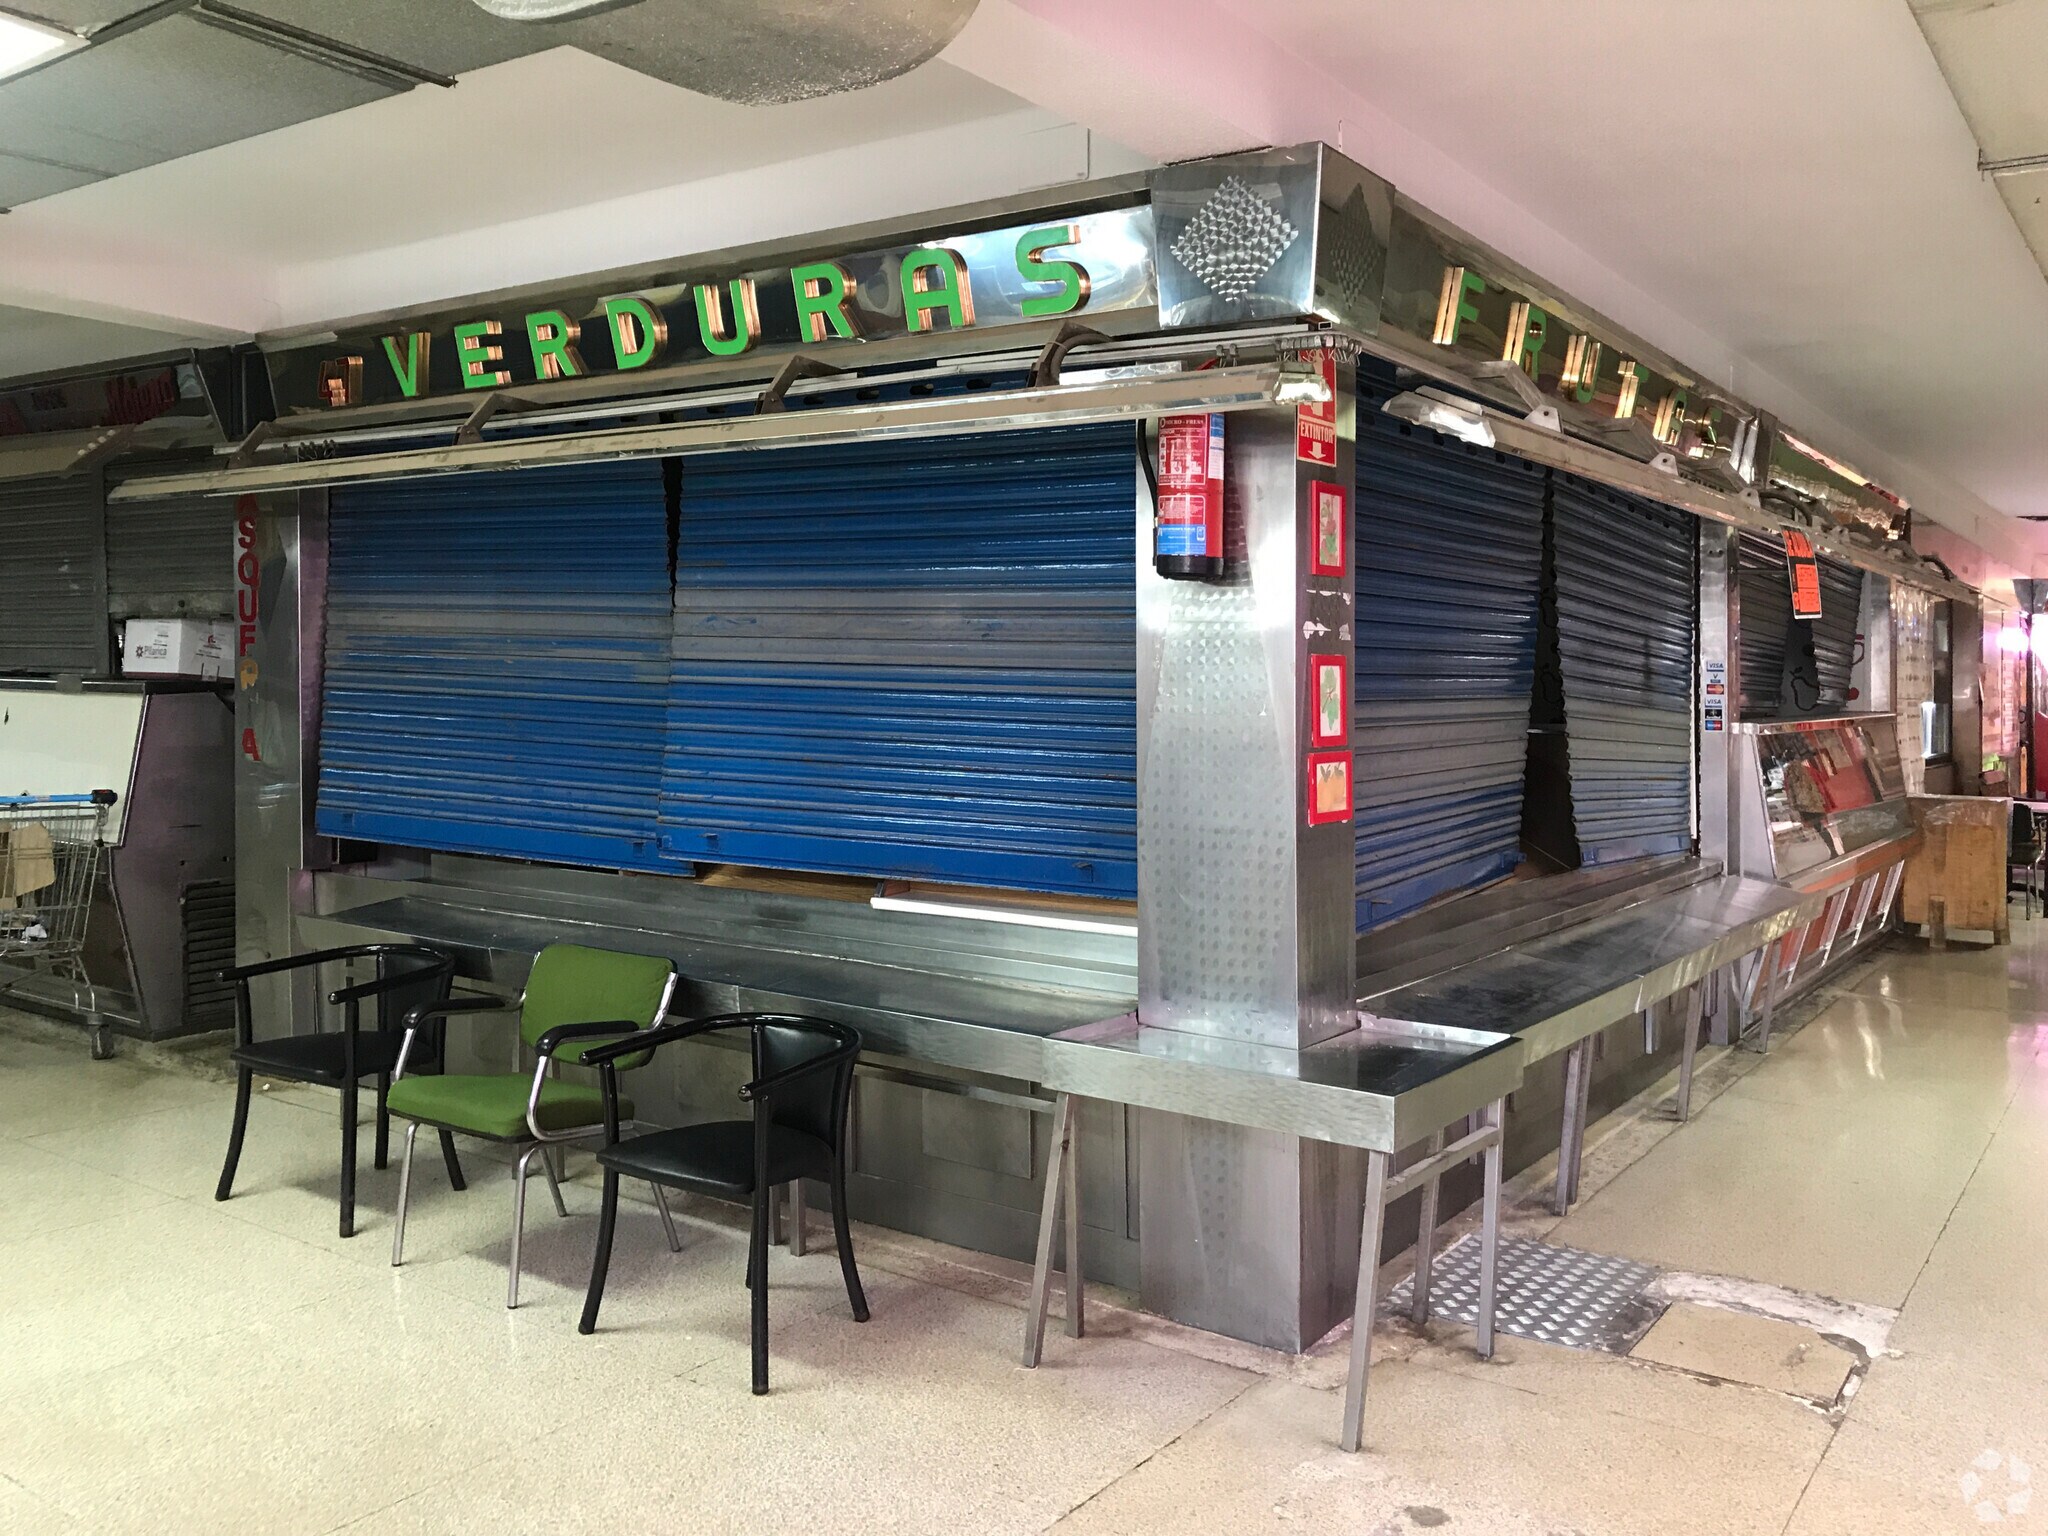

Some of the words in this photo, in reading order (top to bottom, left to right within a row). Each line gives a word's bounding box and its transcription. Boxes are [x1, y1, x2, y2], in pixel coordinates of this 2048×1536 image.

[382, 224, 1090, 398] VERDURAS
[1431, 265, 1722, 460] FRUTAS
[1300, 421, 1335, 444] EXTINTOR
